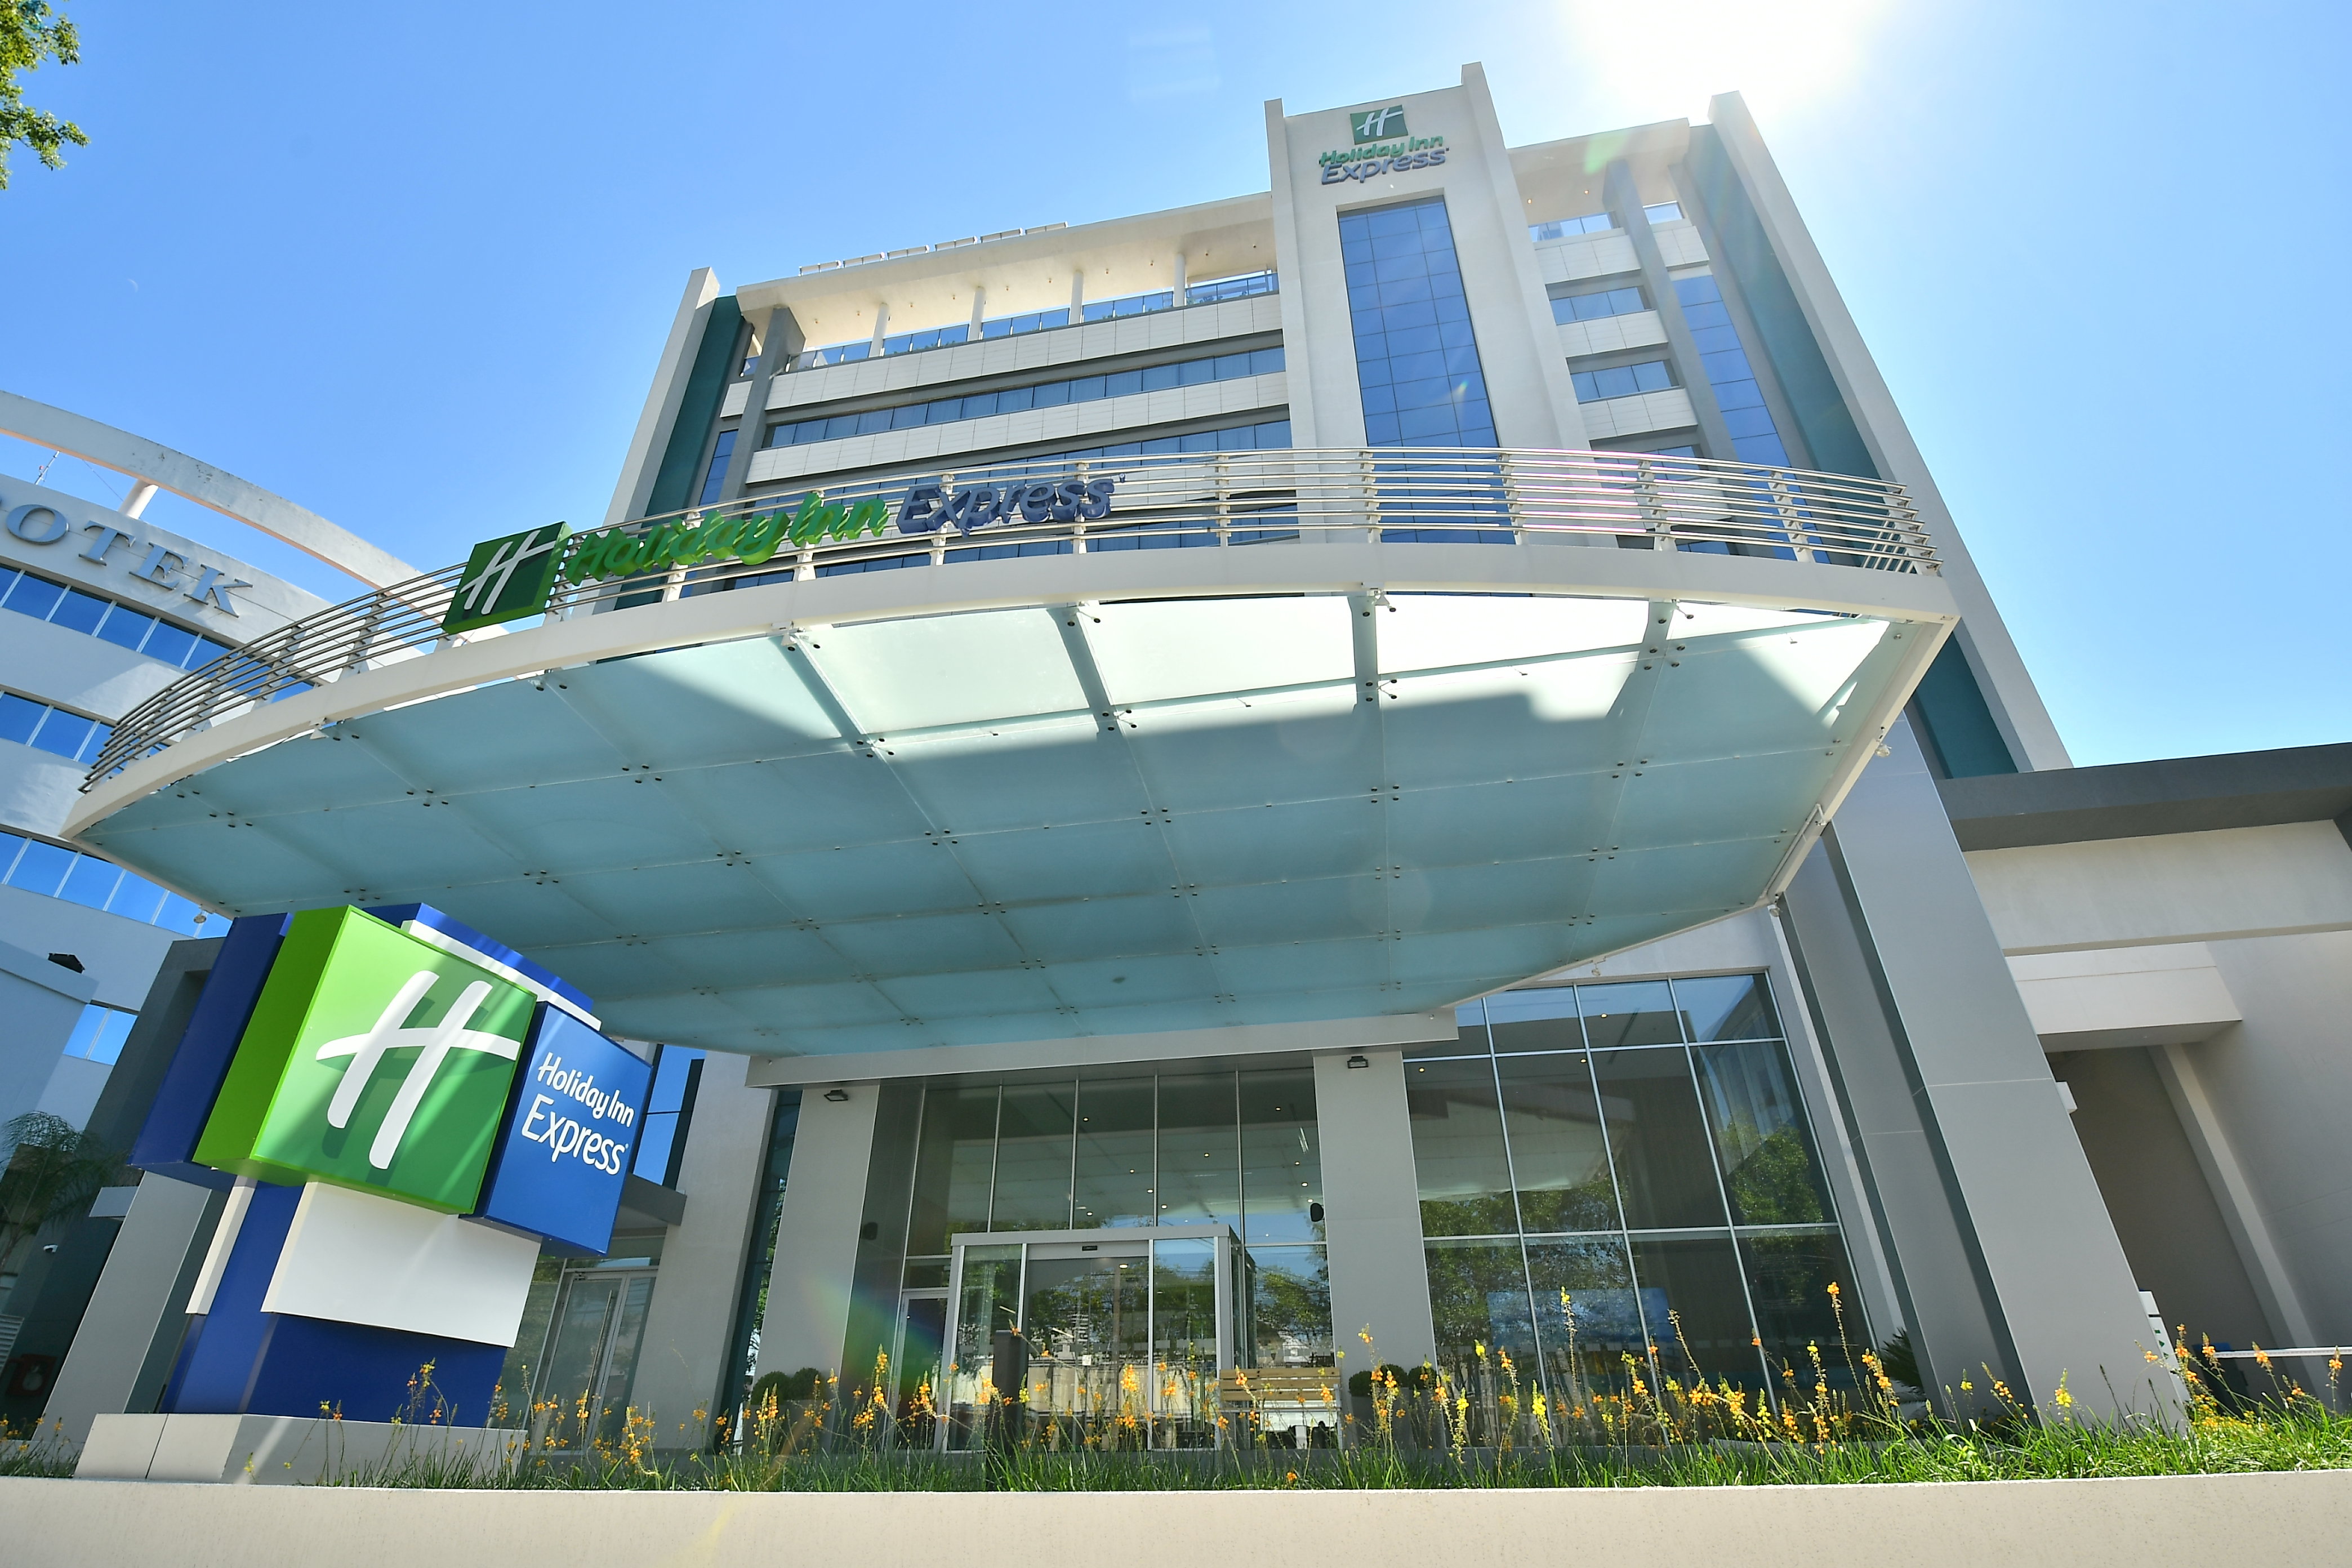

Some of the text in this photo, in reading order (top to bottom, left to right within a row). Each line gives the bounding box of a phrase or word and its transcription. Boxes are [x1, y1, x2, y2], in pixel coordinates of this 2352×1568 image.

[1318, 135, 1444, 167] Holiday Inn
[1356, 108, 1403, 136] H
[1321, 149, 1447, 185] Express
[0, 498, 253, 618] OTEK
[460, 529, 556, 615] H
[564, 478, 1116, 586] Holiday Inn Express
[315, 969, 520, 1170] H
[537, 1052, 634, 1128] Holiday Inn
[522, 1093, 626, 1175] Express
